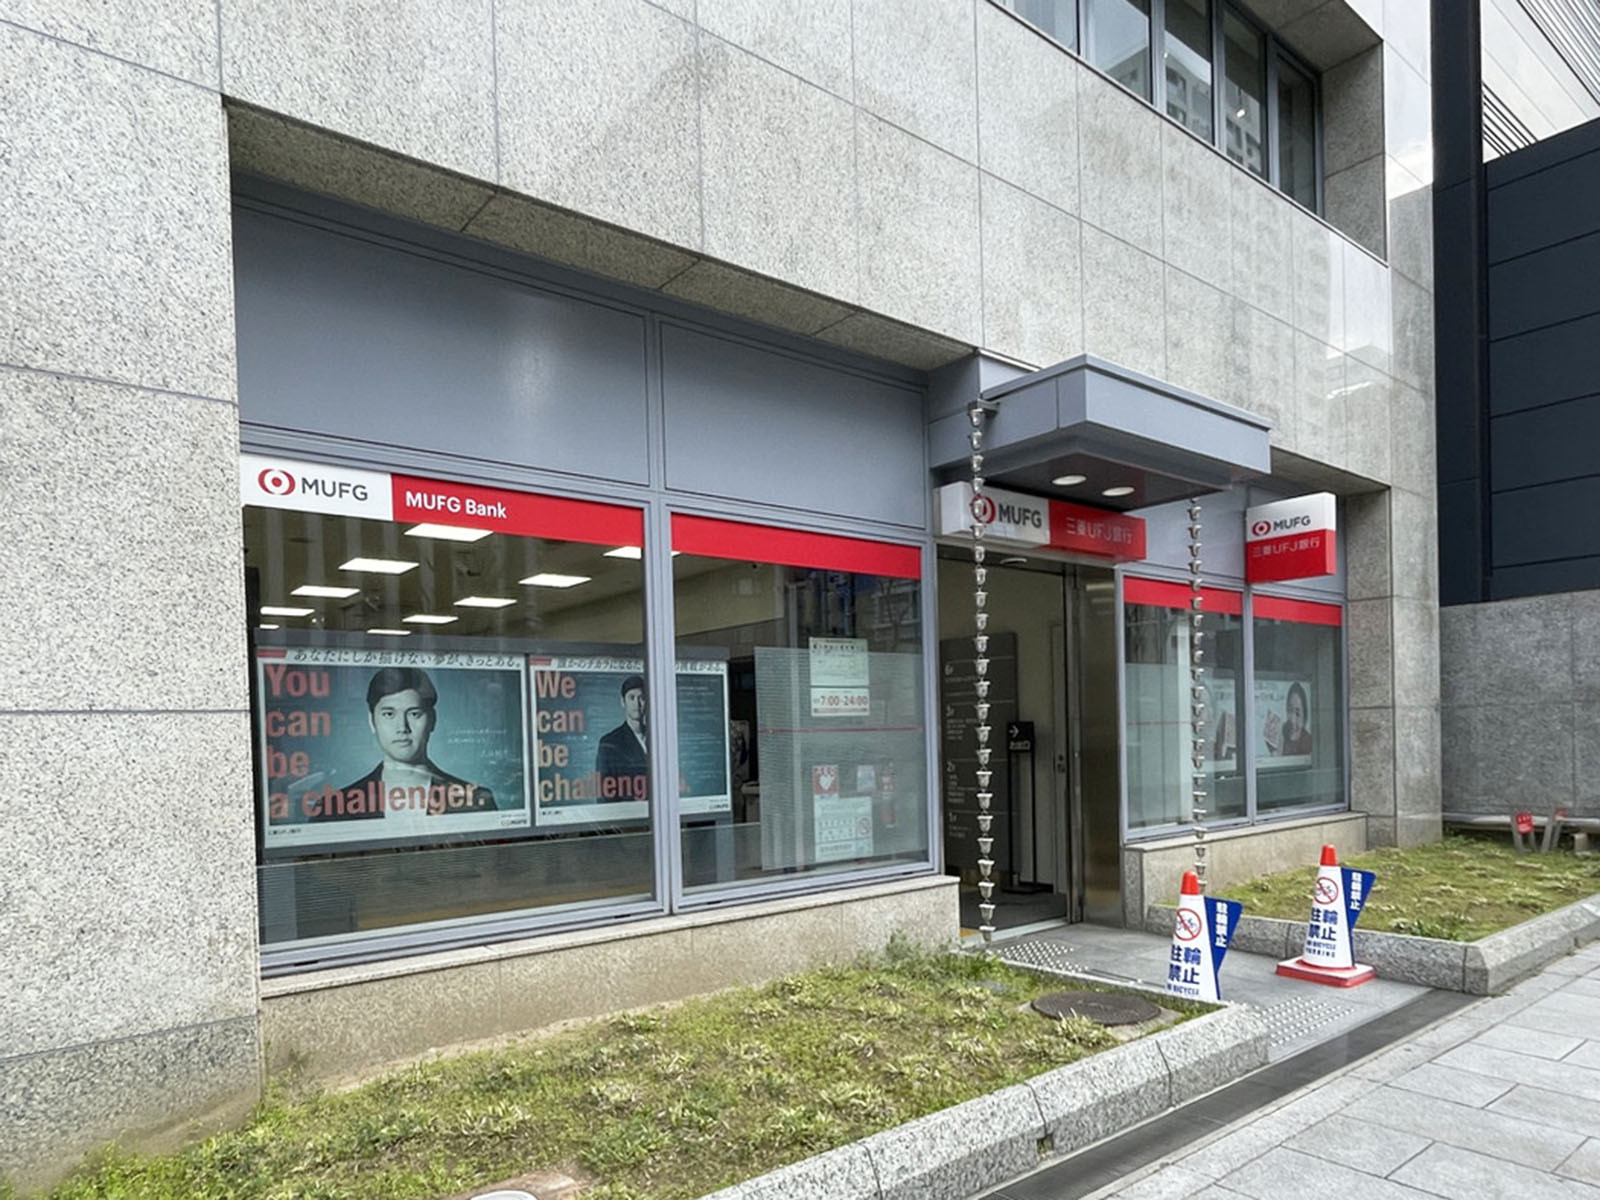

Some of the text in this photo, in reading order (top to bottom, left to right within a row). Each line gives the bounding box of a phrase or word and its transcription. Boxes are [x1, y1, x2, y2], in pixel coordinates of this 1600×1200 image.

[302, 477, 368, 502] MUFG
[406, 491, 507, 519] MUFG Bank
[997, 503, 1042, 528] MUFG
[1273, 515, 1312, 532] MUFG
[265, 664, 330, 698] You
[536, 670, 576, 699] We
[266, 710, 331, 737] can
[537, 710, 584, 733] can
[267, 745, 310, 779] be
[538, 740, 569, 767] be
[269, 780, 486, 819] a challenger.
